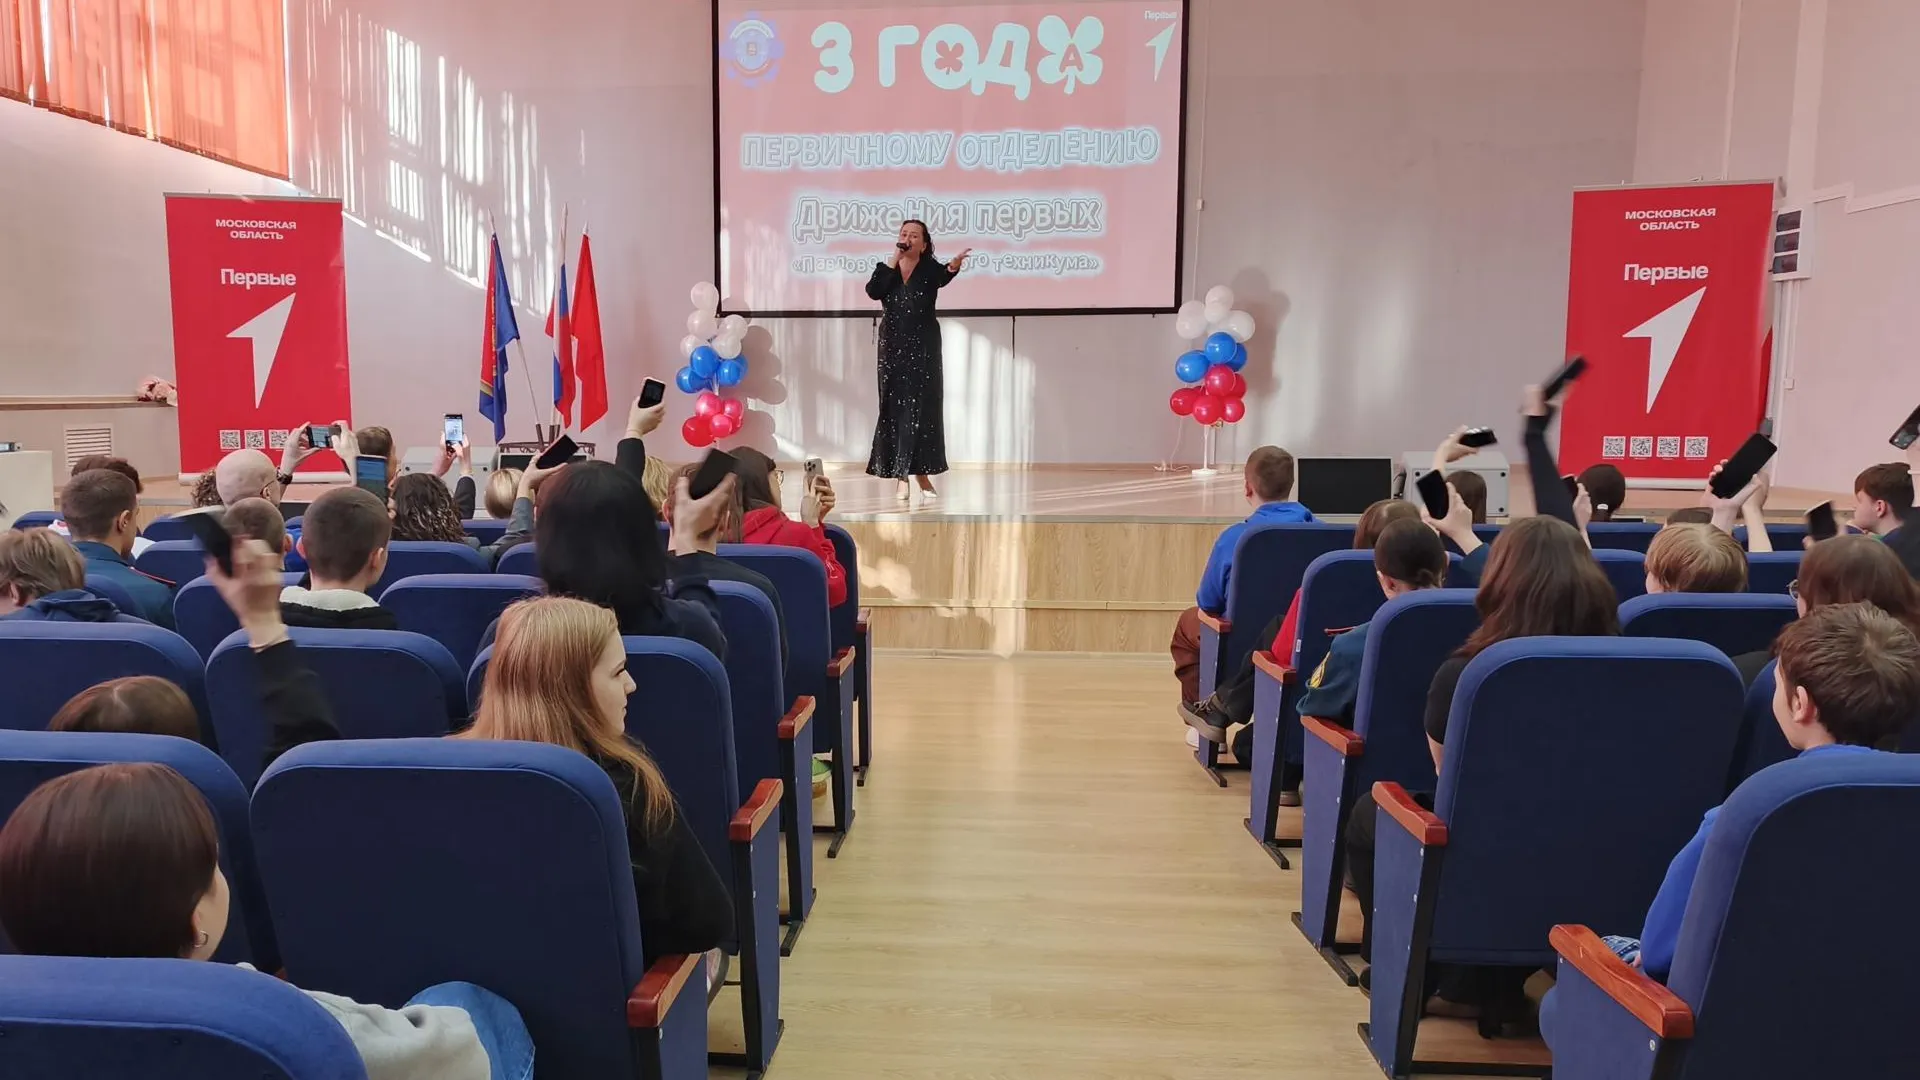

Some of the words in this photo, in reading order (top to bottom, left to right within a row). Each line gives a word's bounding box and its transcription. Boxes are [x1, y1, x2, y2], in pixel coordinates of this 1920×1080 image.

[741, 134, 952, 169] ПЕРВИЧНОМУ
[956, 129, 1160, 170] ОТДЕЛЕНИЮ
[973, 199, 1103, 242] первых
[1625, 207, 1717, 219] МОСКОВСКАЯ
[215, 219, 297, 230] МОСКОВСКАЯ
[230, 231, 284, 240] ОБЛАСТЬ
[1639, 221, 1701, 231] ОБЛАСТЬ
[992, 253, 1099, 276] техникума»
[1624, 263, 1708, 285] Первые
[220, 268, 297, 290] Первые
